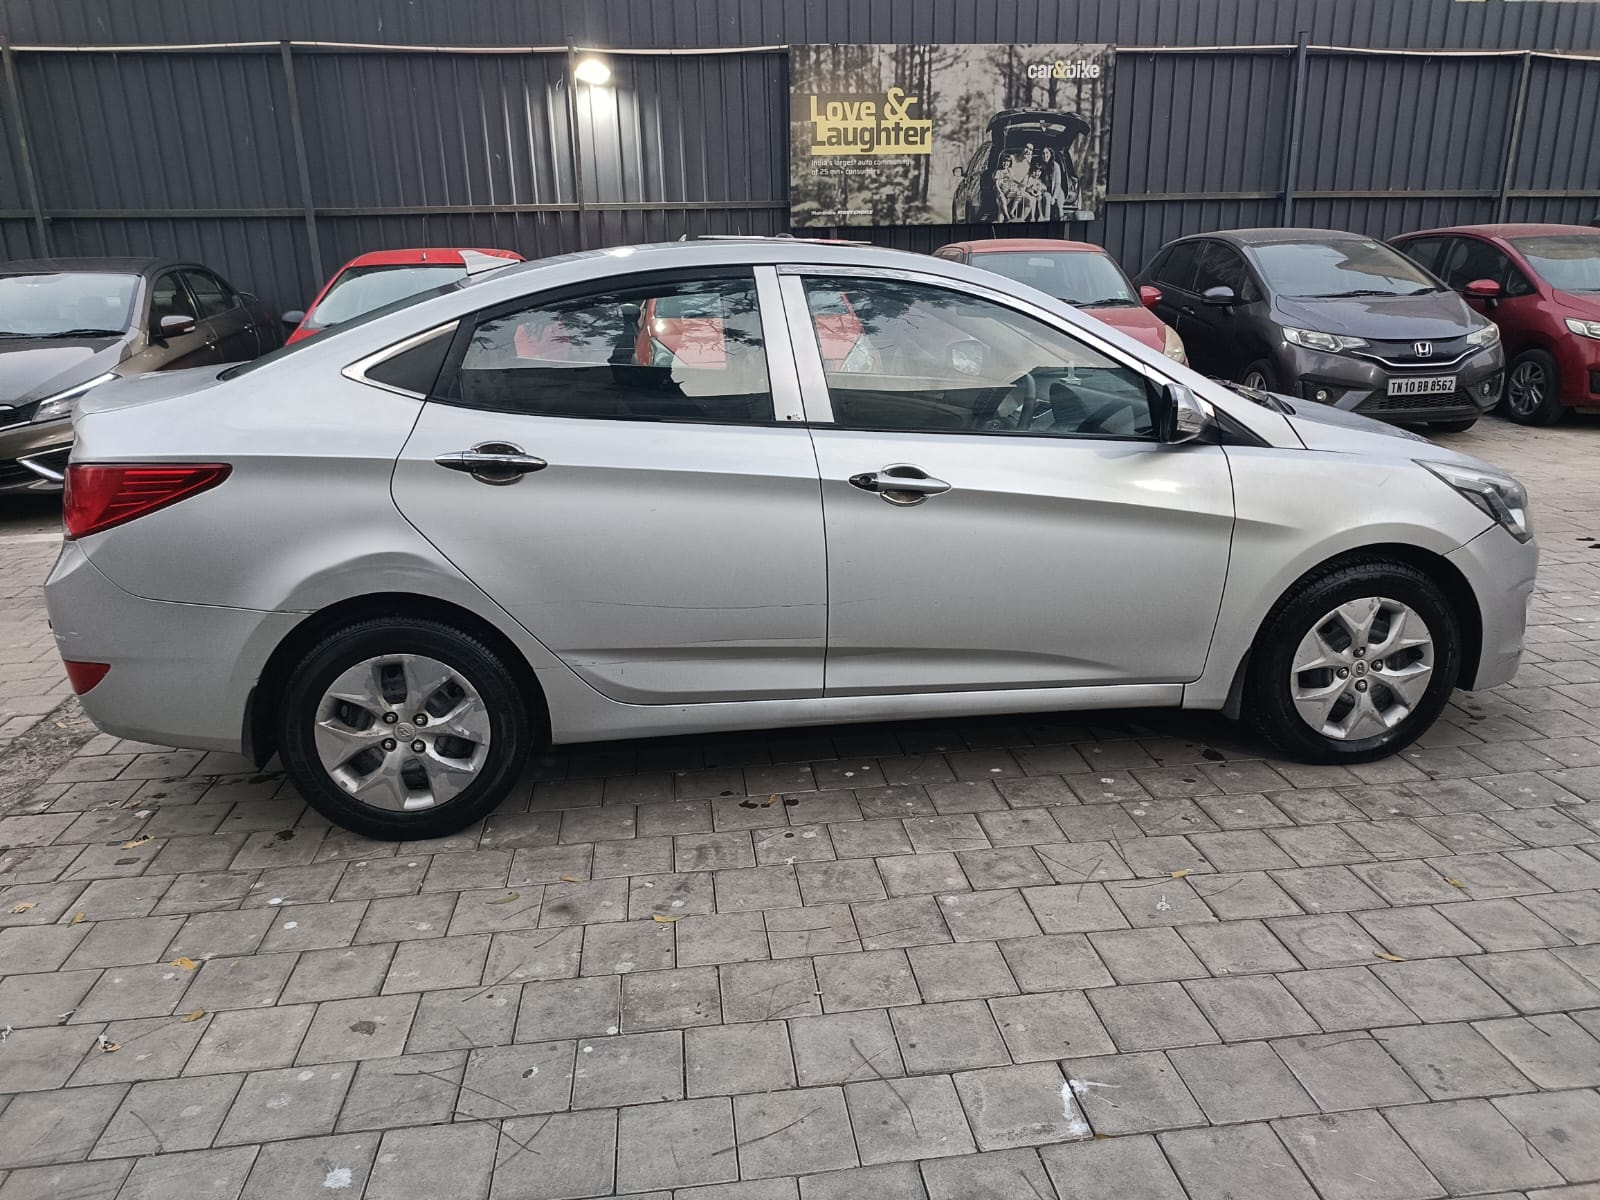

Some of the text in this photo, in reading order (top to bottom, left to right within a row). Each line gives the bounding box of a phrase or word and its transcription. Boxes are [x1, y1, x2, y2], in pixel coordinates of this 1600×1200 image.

[1027, 60, 1100, 79] car&bike
[810, 87, 918, 121] Love &
[811, 121, 930, 152] Laughter
[811, 159, 833, 167] India's
[1392, 380, 1453, 393] TN 10 BB 8562
